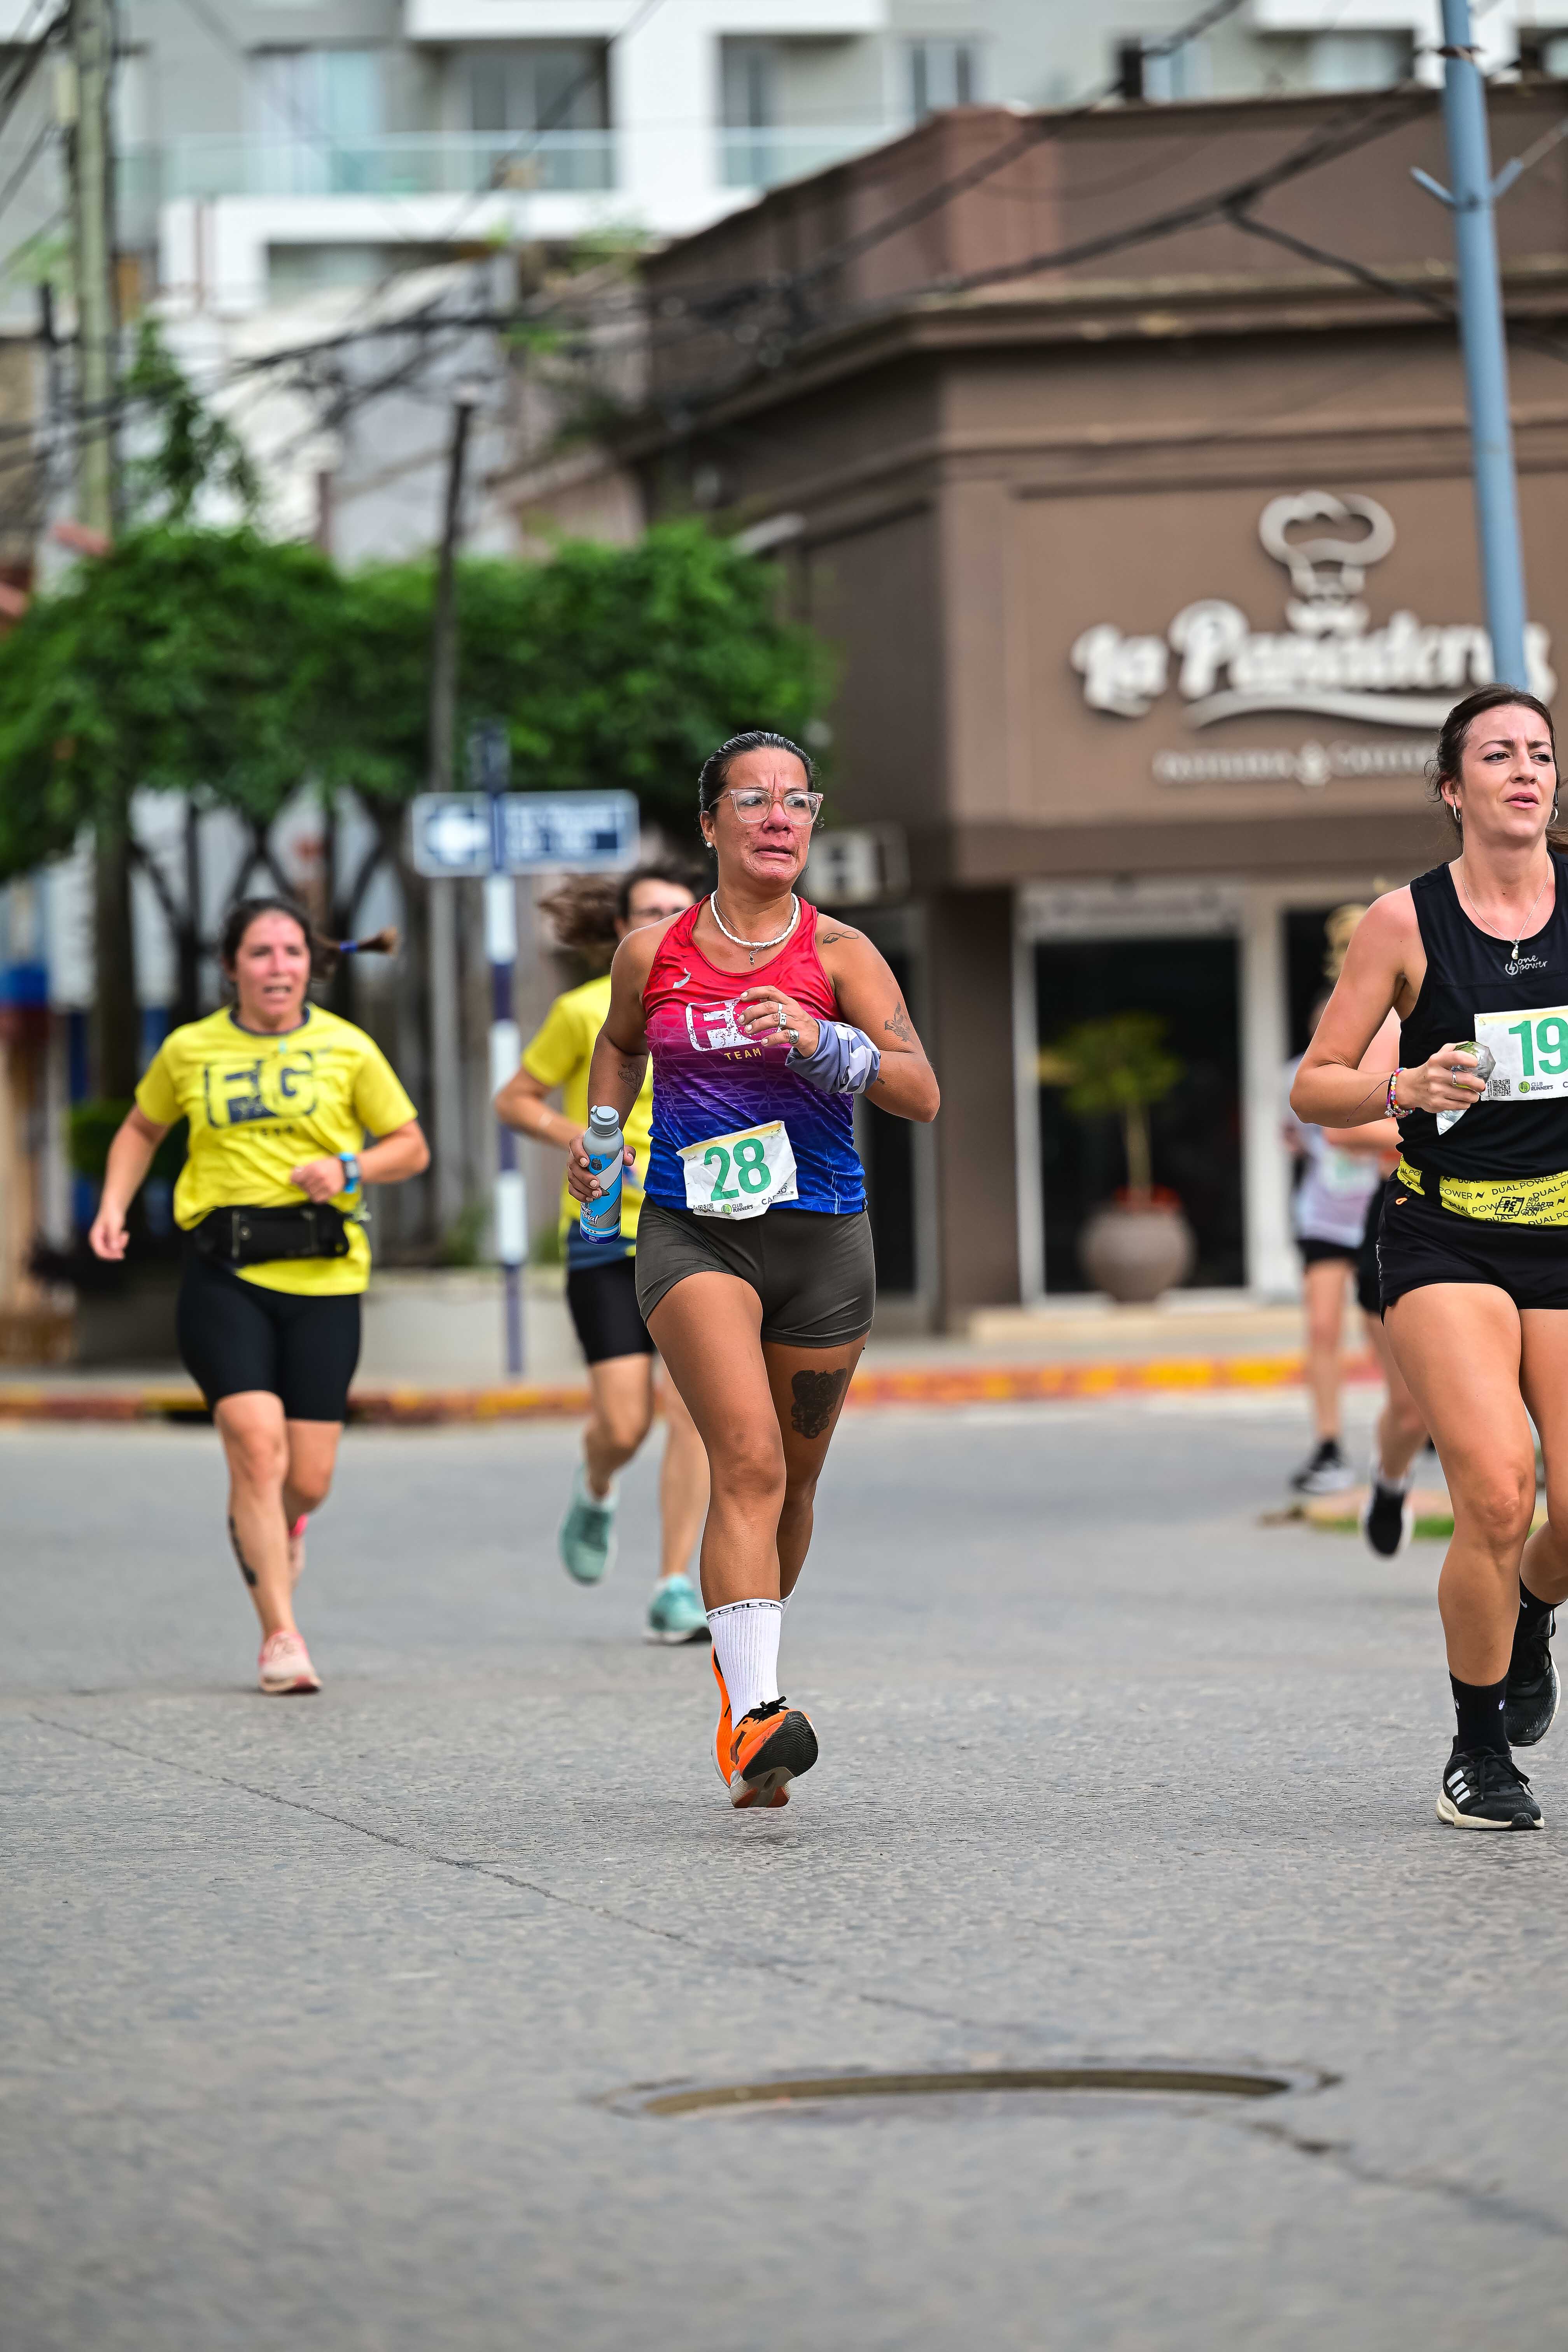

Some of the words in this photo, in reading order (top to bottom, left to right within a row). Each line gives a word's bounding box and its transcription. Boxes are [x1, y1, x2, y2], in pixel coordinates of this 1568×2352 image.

[1518, 956, 1538, 965] one
[1519, 961, 1548, 974] power
[1508, 1018, 1568, 1076] 19
[724, 1048, 761, 1060] TEAM
[704, 1139, 772, 1201] 28
[1439, 1187, 1473, 1200] POWER
[1492, 1185, 1519, 1195] DUAL
[1519, 1175, 1559, 1189] POWER
[1533, 1186, 1557, 1198] DUAL
[1528, 1215, 1556, 1225] DUAL
